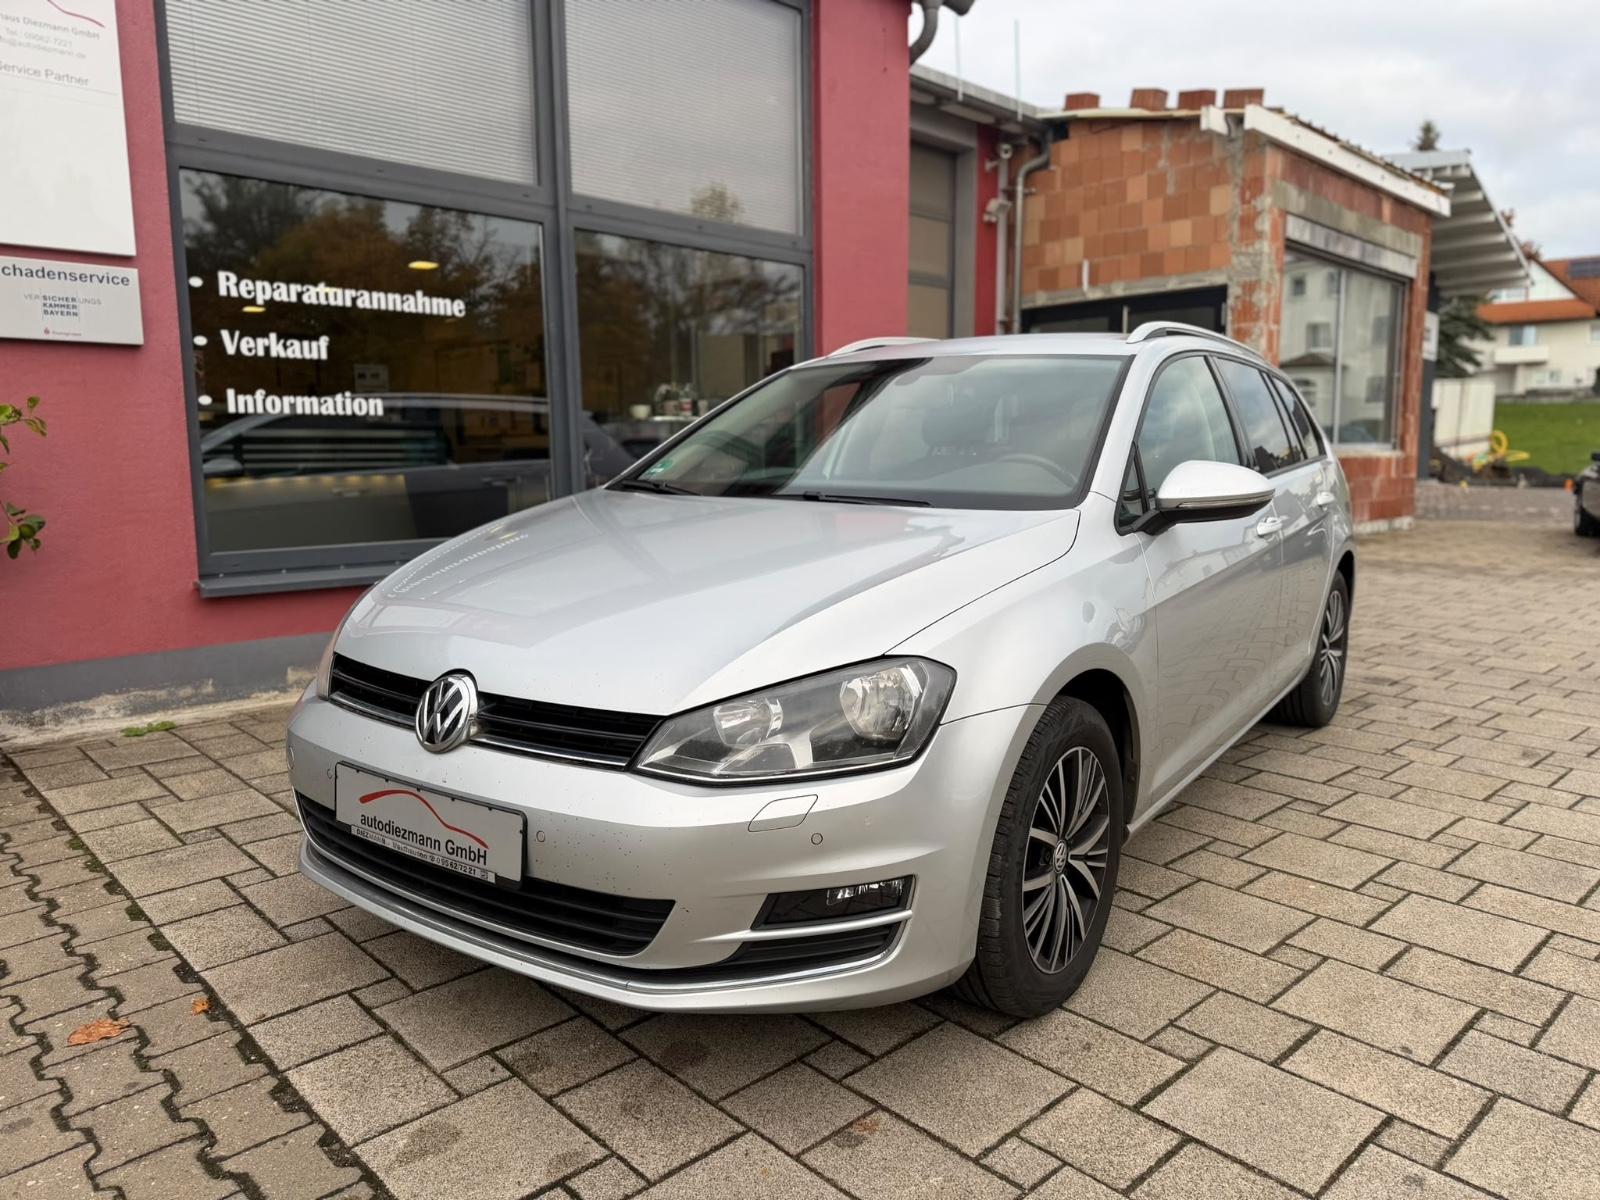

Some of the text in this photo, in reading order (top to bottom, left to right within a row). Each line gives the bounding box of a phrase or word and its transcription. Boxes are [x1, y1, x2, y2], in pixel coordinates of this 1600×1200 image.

[44, 68, 89, 86] Partner
[1, 263, 130, 286] chadenservice
[42, 302, 77, 310] KAMMER
[217, 270, 466, 318] Reparaturannahme
[43, 309, 79, 317] BAYERN
[220, 329, 330, 360] Verkauf
[226, 388, 384, 416] Information
[360, 813, 487, 866] autodiezmann GmbH
